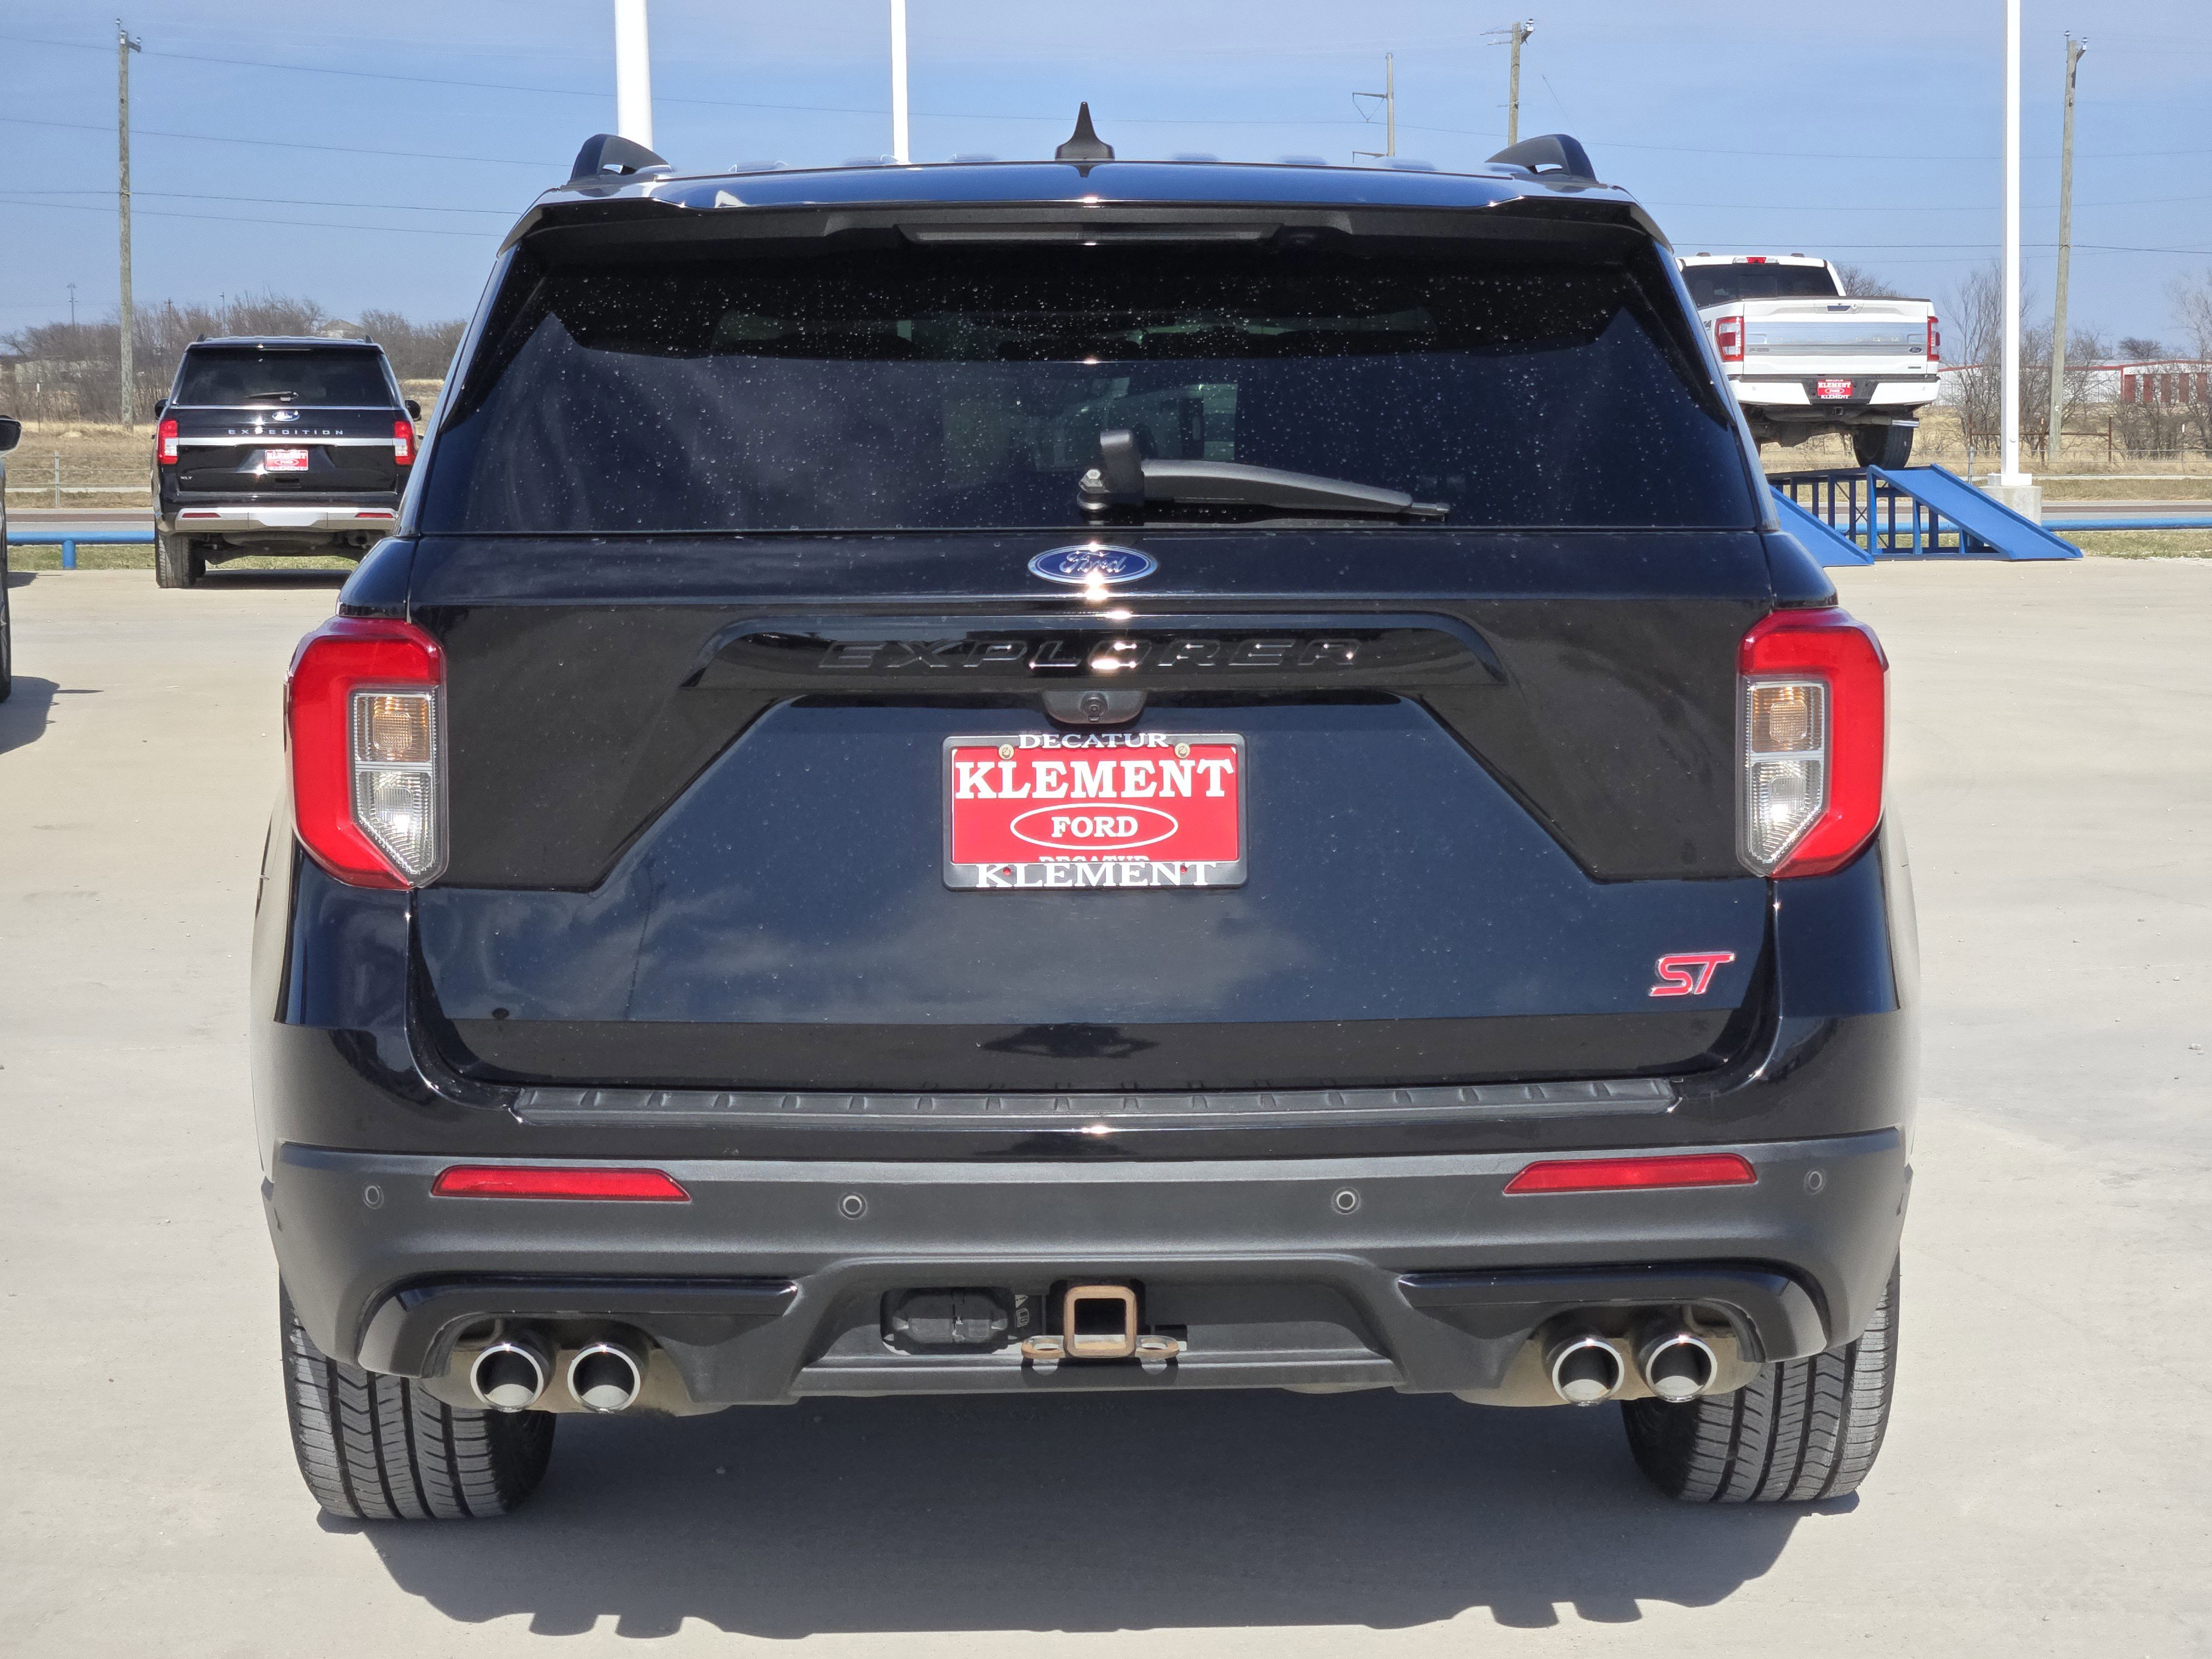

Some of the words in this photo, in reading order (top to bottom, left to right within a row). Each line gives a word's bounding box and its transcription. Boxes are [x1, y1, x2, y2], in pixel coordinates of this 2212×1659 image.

[1059, 551, 1127, 573] Ford
[818, 639, 1362, 669] EXPLORER
[1019, 733, 1169, 749] DECATUR
[955, 758, 1234, 799] KLEMENT
[1051, 816, 1139, 838] FORD
[975, 862, 1217, 888] KLEMENT
[1648, 951, 1735, 997] ST
